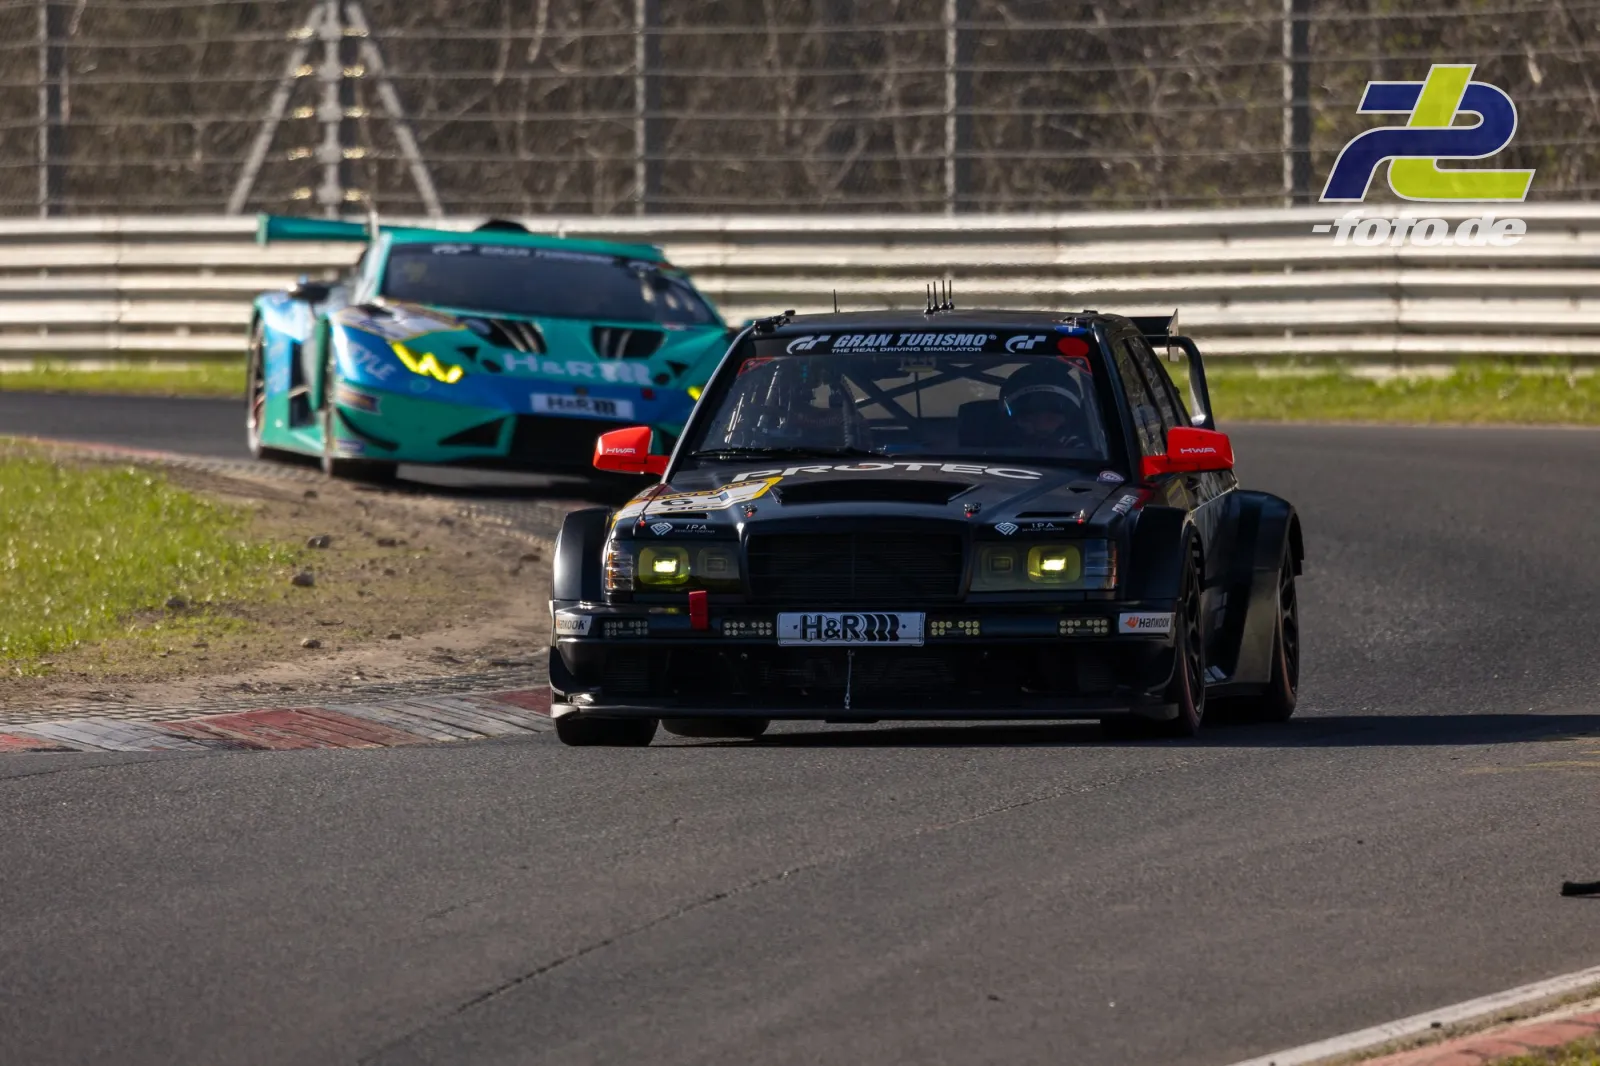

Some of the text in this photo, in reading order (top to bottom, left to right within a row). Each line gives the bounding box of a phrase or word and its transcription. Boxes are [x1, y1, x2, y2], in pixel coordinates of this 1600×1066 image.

[833, 333, 893, 348] GRAN
[731, 462, 1043, 483] PROTEC
[801, 614, 867, 642] H&R
